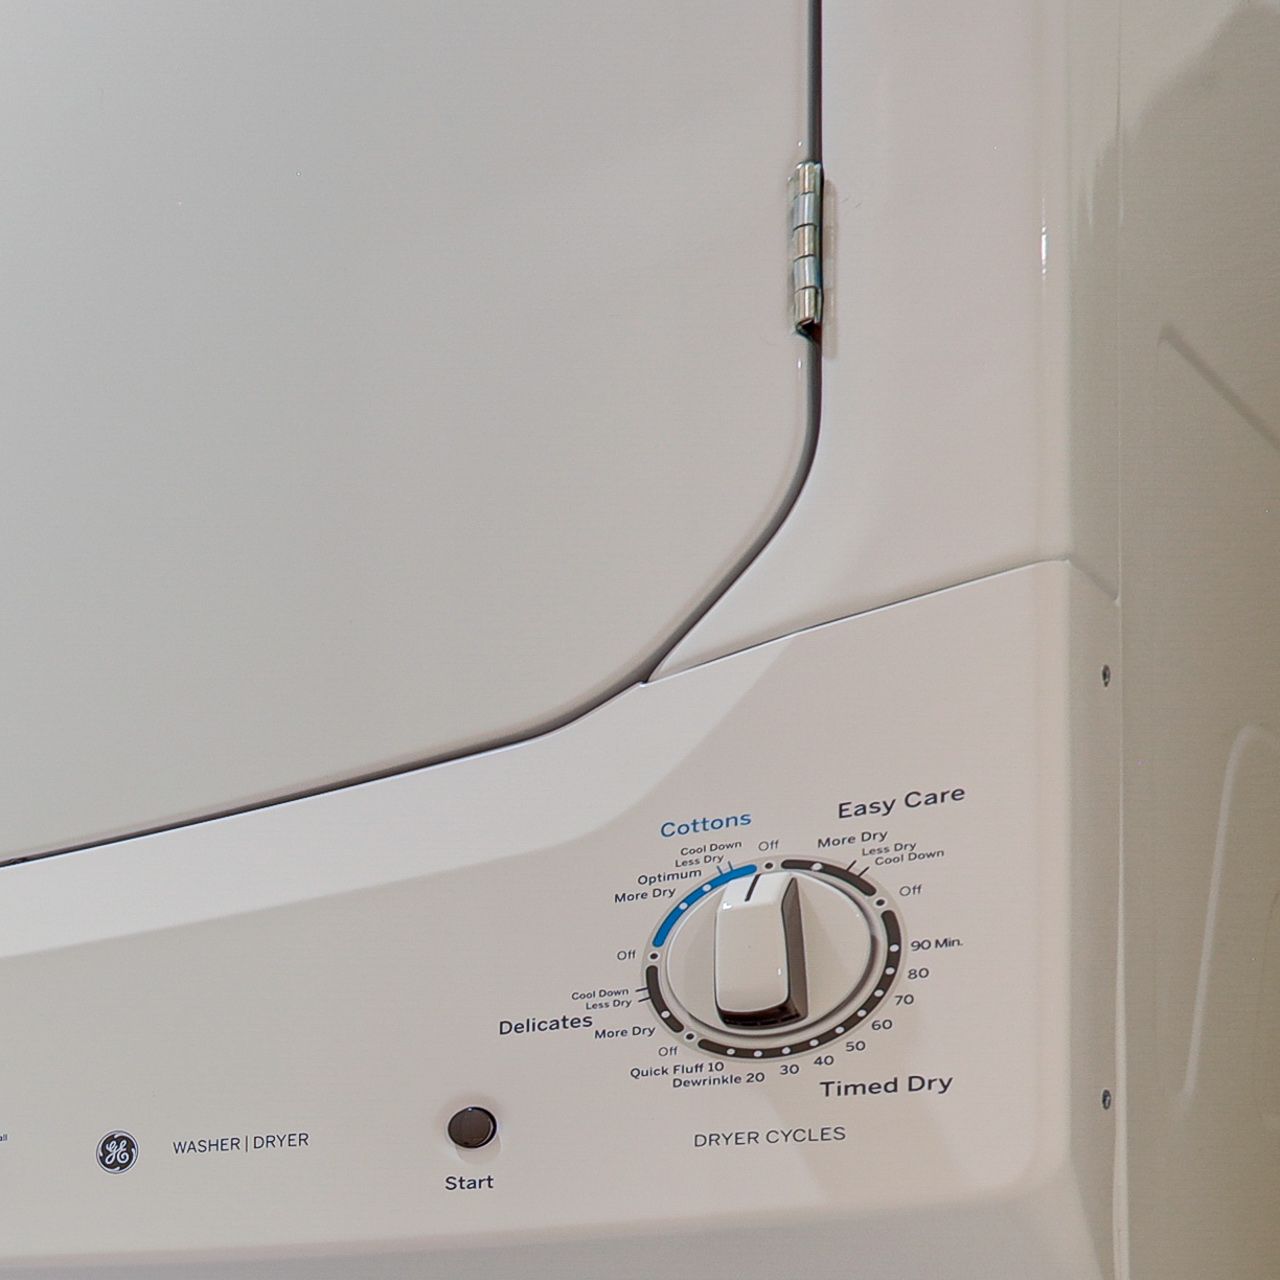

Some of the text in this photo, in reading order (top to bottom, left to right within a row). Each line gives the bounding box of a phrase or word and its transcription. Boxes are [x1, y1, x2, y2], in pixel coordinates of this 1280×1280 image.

[838, 787, 965, 819] Easy Care
[661, 813, 752, 838] Cottons
[758, 840, 779, 851] Off
[817, 831, 888, 848] More Dry
[680, 840, 742, 856] Cool Down
[862, 842, 917, 857] Less Dry
[675, 854, 724, 868] Less Dry
[875, 849, 944, 866] Cool Down
[637, 869, 702, 886] Optimum
[614, 887, 677, 903] More Dry
[899, 885, 922, 897] Off
[910, 937, 964, 951] 90 Min.
[617, 950, 636, 961] Off
[907, 968, 929, 980] 80
[571, 988, 629, 1001] Cool Down
[895, 994, 914, 1006] 70
[586, 999, 632, 1010] Less Dry
[499, 1015, 593, 1035] Delicates
[871, 1019, 893, 1030] 60
[594, 1026, 656, 1039] More Dry
[658, 1047, 678, 1057] Off
[846, 1040, 866, 1052] 50
[813, 1055, 834, 1066] 40
[630, 1061, 725, 1079] Quick Fluff 10
[780, 1064, 800, 1075] 30
[673, 1072, 765, 1088] Dewrinkle 20
[820, 1075, 953, 1097] Timed Dry
[172, 1132, 309, 1155] WASHER DRYER
[694, 1126, 846, 1147] DRYER CYCLES
[444, 1174, 494, 1191] Start
